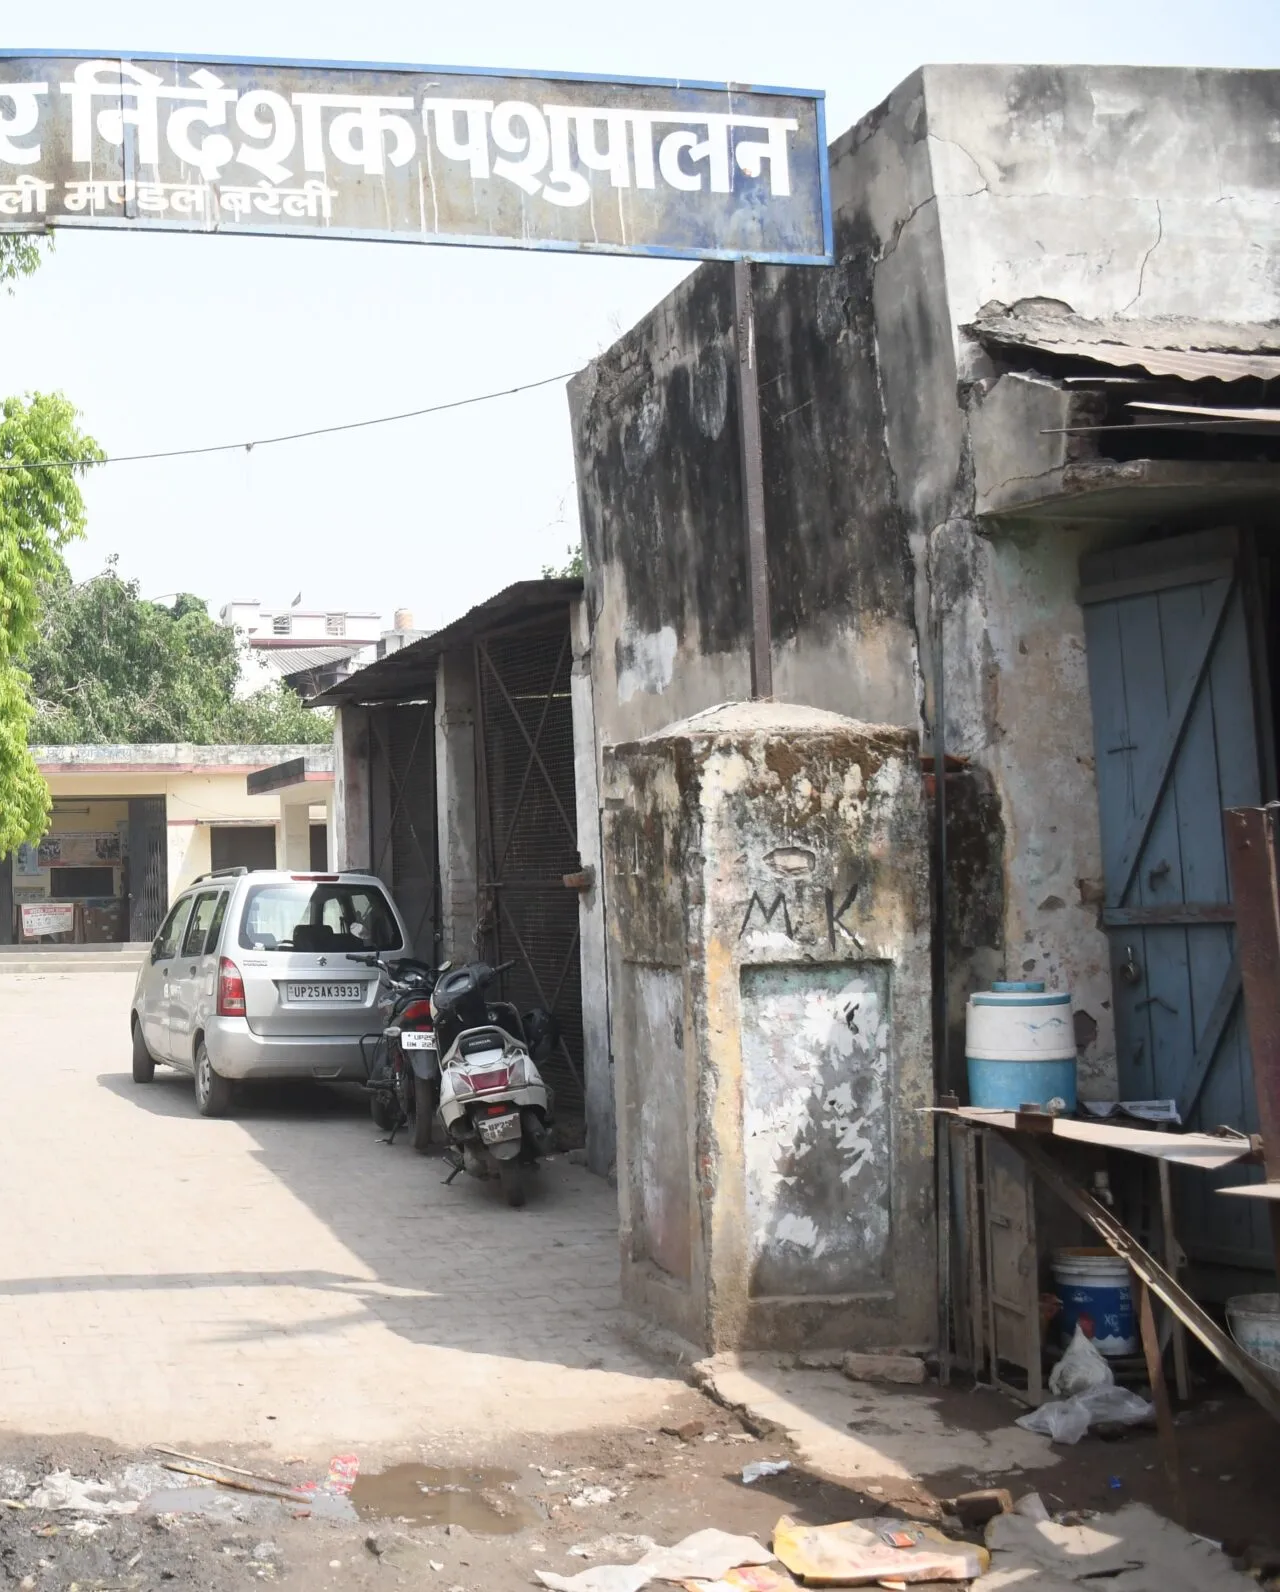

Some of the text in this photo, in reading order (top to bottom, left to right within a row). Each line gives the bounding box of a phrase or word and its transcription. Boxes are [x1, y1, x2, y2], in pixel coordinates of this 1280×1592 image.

[60, 60, 422, 184] निदेशक
[423, 96, 799, 205] पशुपालन
[219, 179, 338, 218] बरेली
[293, 985, 360, 998] UP25AK3933
